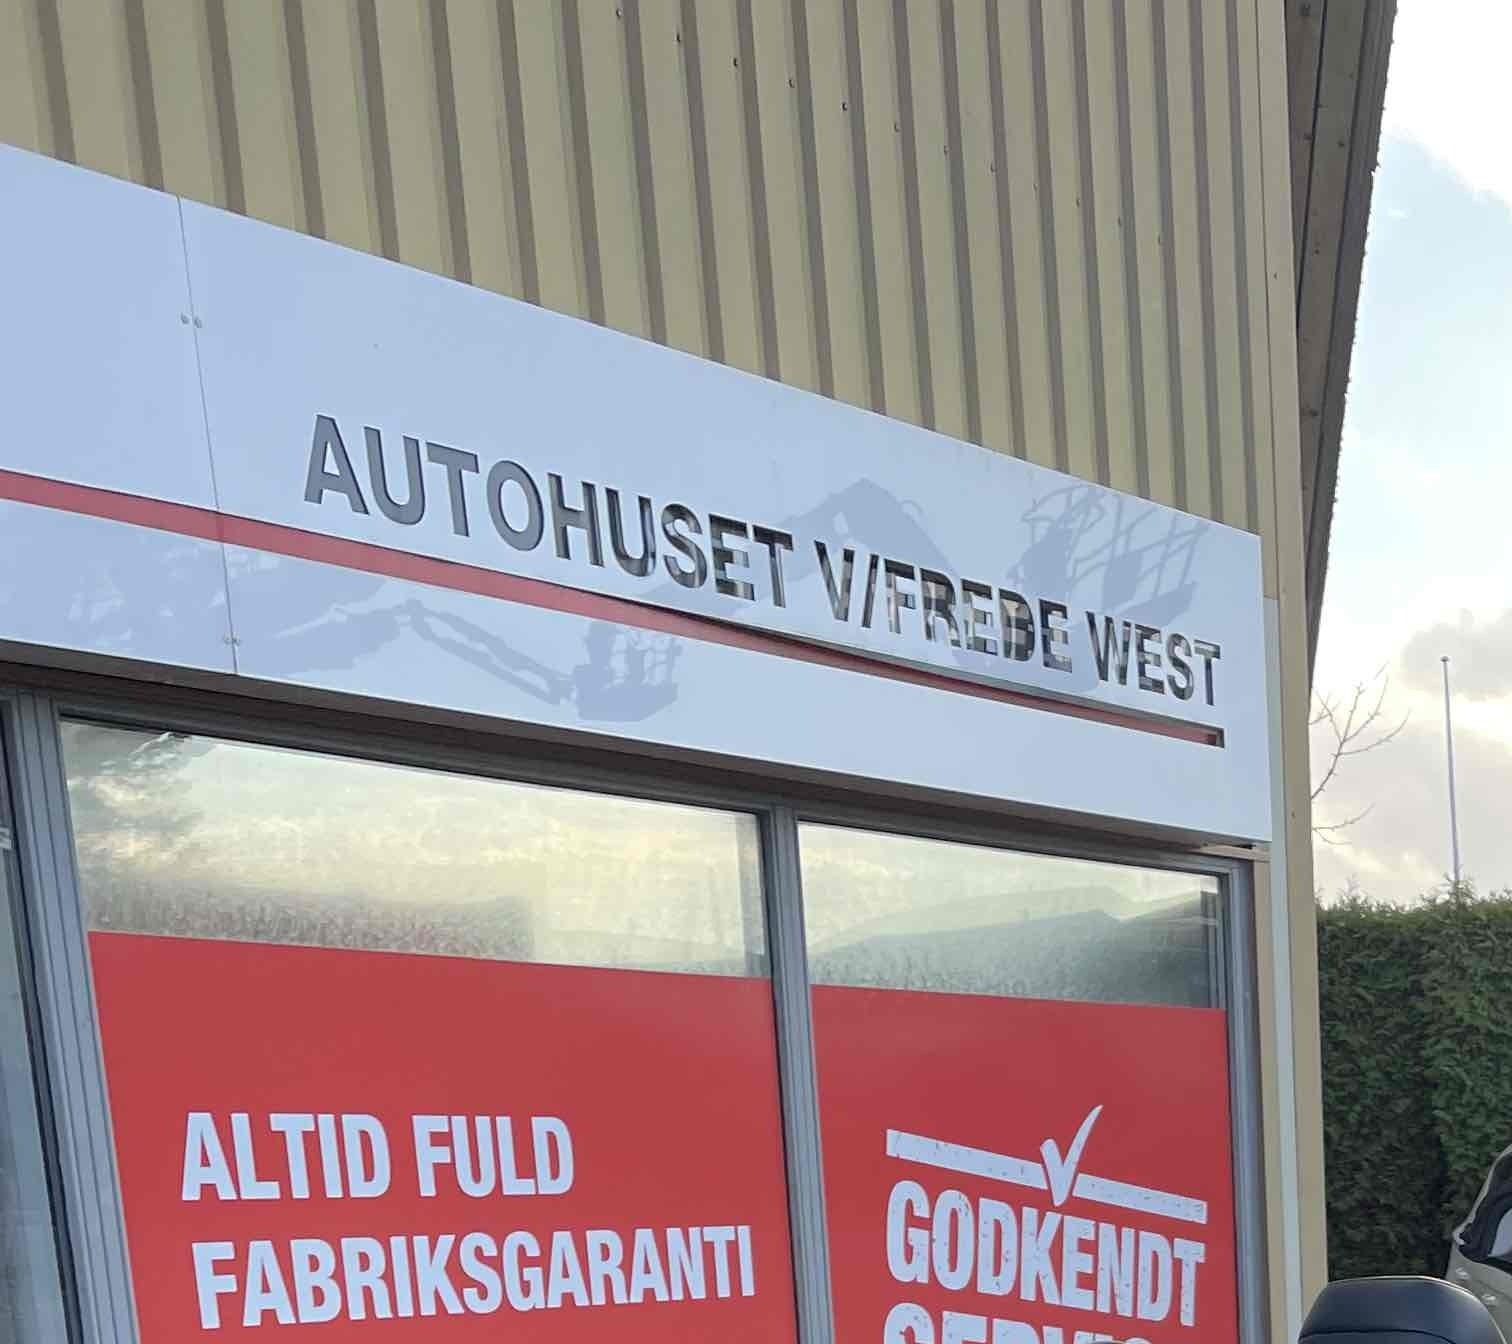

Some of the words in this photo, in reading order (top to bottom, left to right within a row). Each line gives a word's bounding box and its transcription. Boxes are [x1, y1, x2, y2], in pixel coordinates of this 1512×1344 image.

[304, 414, 795, 608] AUTOHUSET
[813, 540, 1073, 674] V/FREDE
[1085, 610, 1222, 706] WEST
[182, 1112, 392, 1201] ALTID
[411, 1114, 574, 1198] FULD
[192, 1225, 756, 1330] FABRIKSGARANTI
[886, 1180, 1206, 1327] GODKENDT
